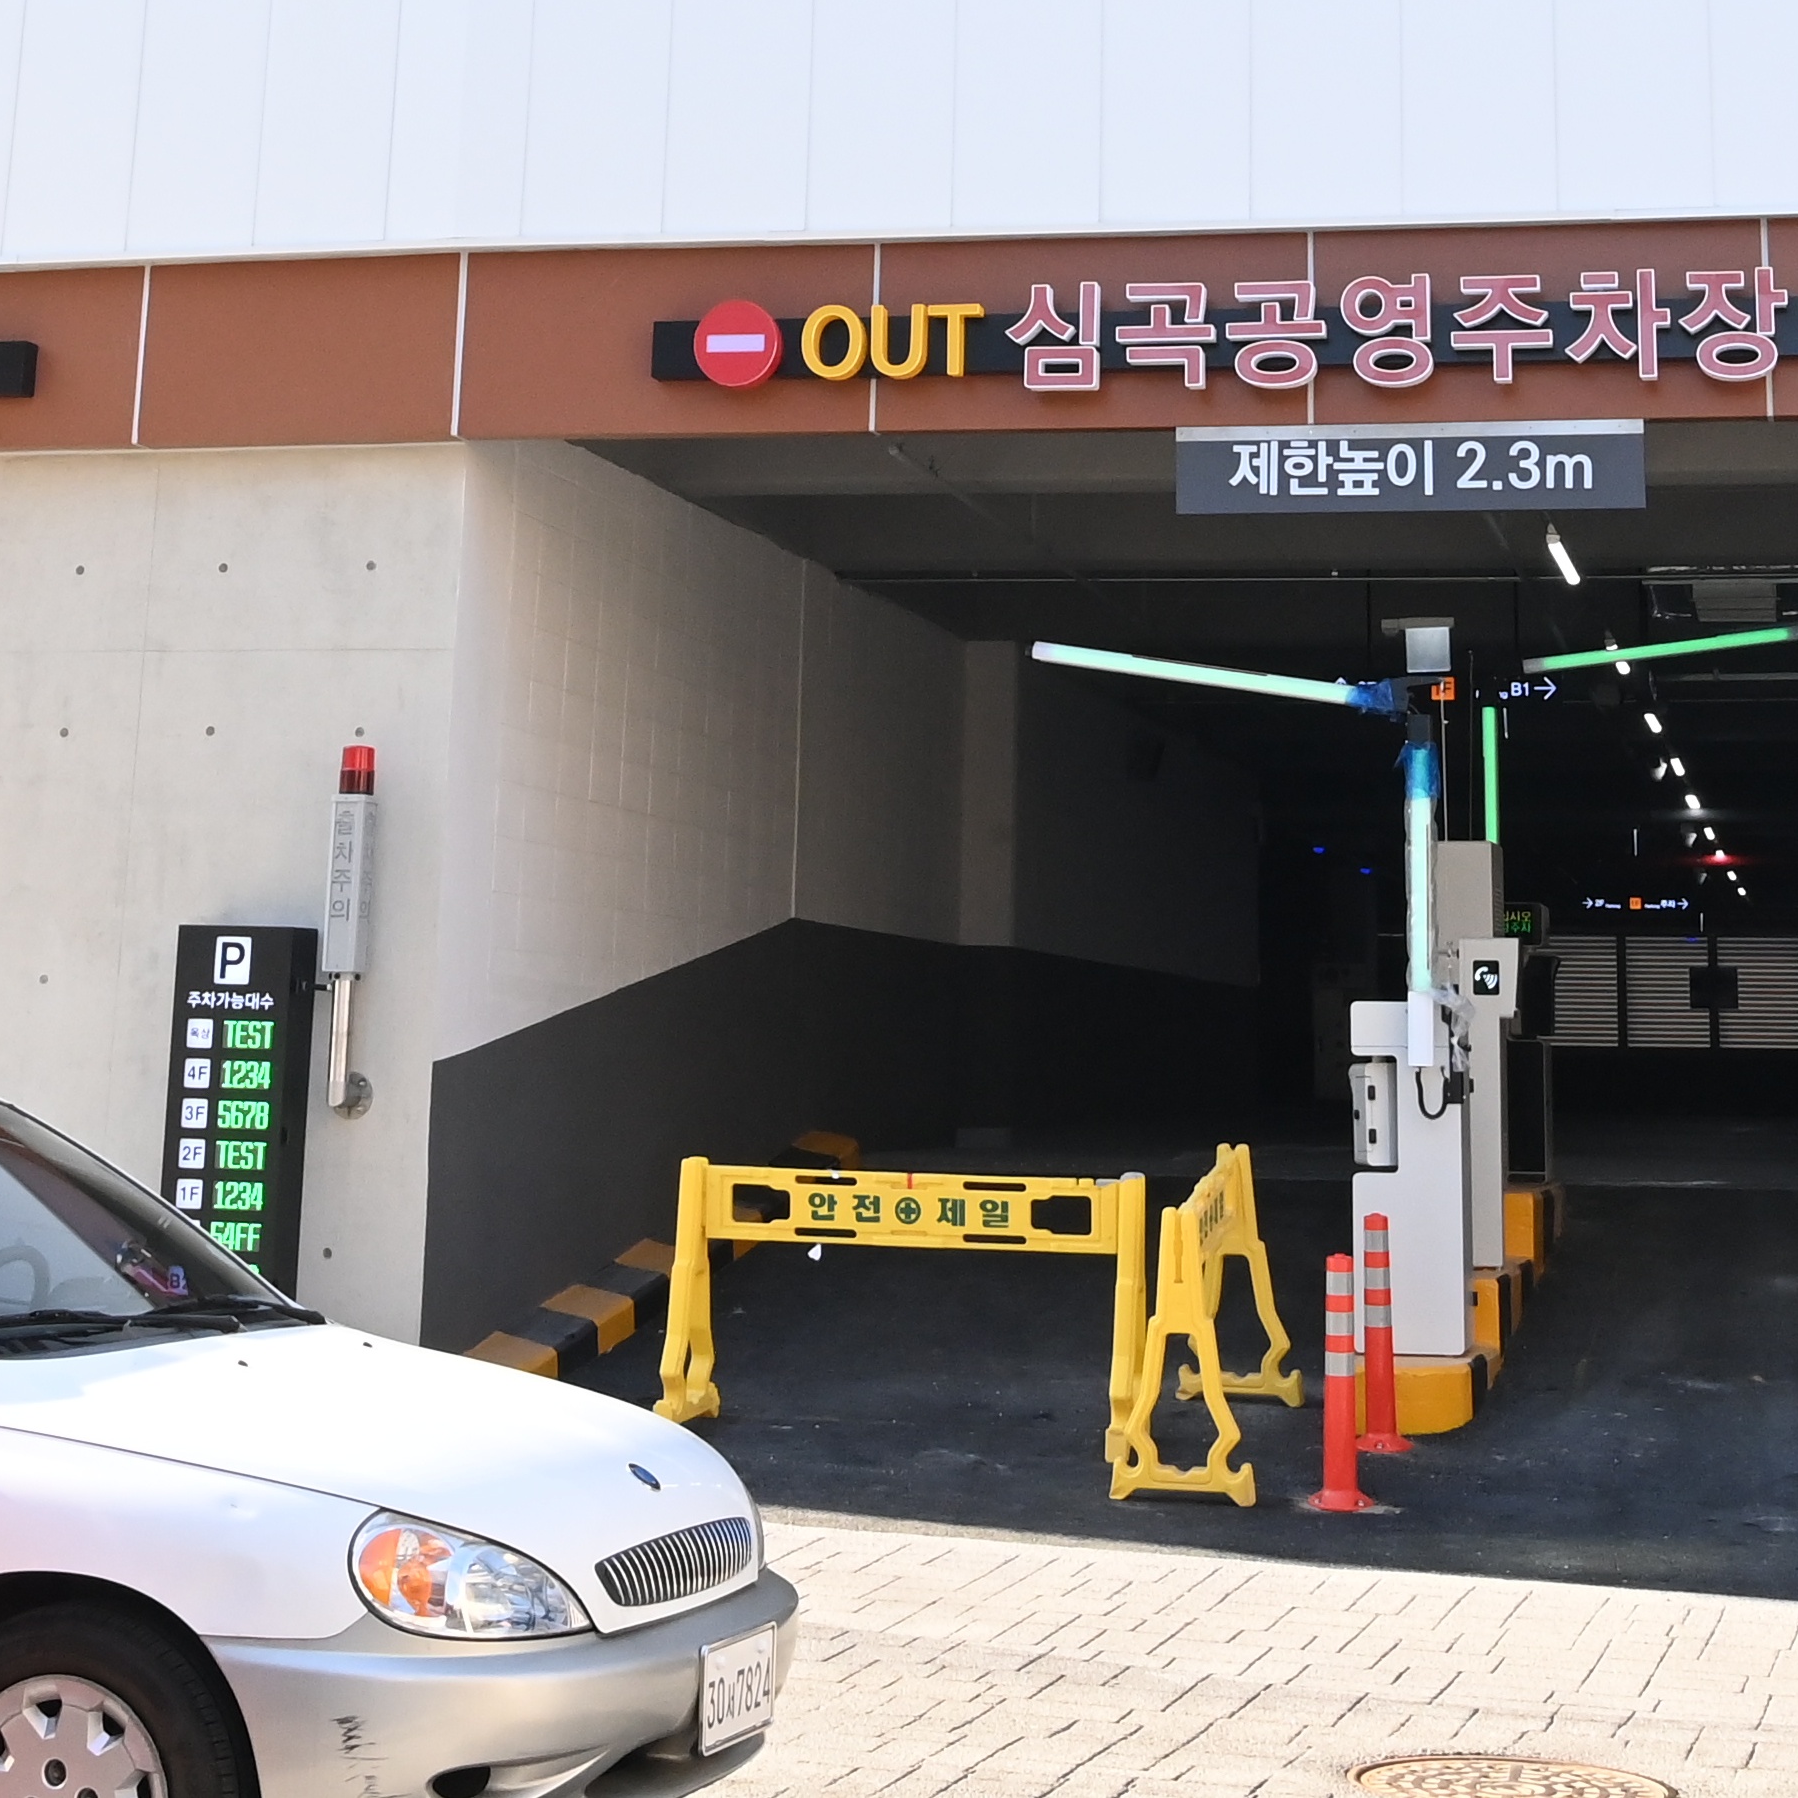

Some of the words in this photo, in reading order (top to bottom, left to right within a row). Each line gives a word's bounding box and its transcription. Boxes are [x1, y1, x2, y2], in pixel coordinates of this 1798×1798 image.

[802, 302, 984, 381] OUT
[1004, 265, 1789, 393] 심곡공영주차장
[1228, 435, 1435, 501] 제한높이
[1455, 440, 1594, 493] 2.3m
[1511, 681, 1530, 697] B1
[330, 810, 354, 922] 출차주의
[219, 942, 245, 979] P
[187, 991, 275, 1010] 주차가능대수
[223, 1019, 275, 1049] TEST
[187, 1066, 208, 1080] 4F
[221, 1060, 271, 1089] 1234
[184, 1105, 205, 1120] 3F
[217, 1100, 270, 1130] 5678
[182, 1146, 202, 1161] 2F
[215, 1140, 267, 1170] TEST
[180, 1186, 200, 1201] 1F
[213, 1181, 264, 1211] 1234
[707, 1657, 771, 1729] 30서7824
